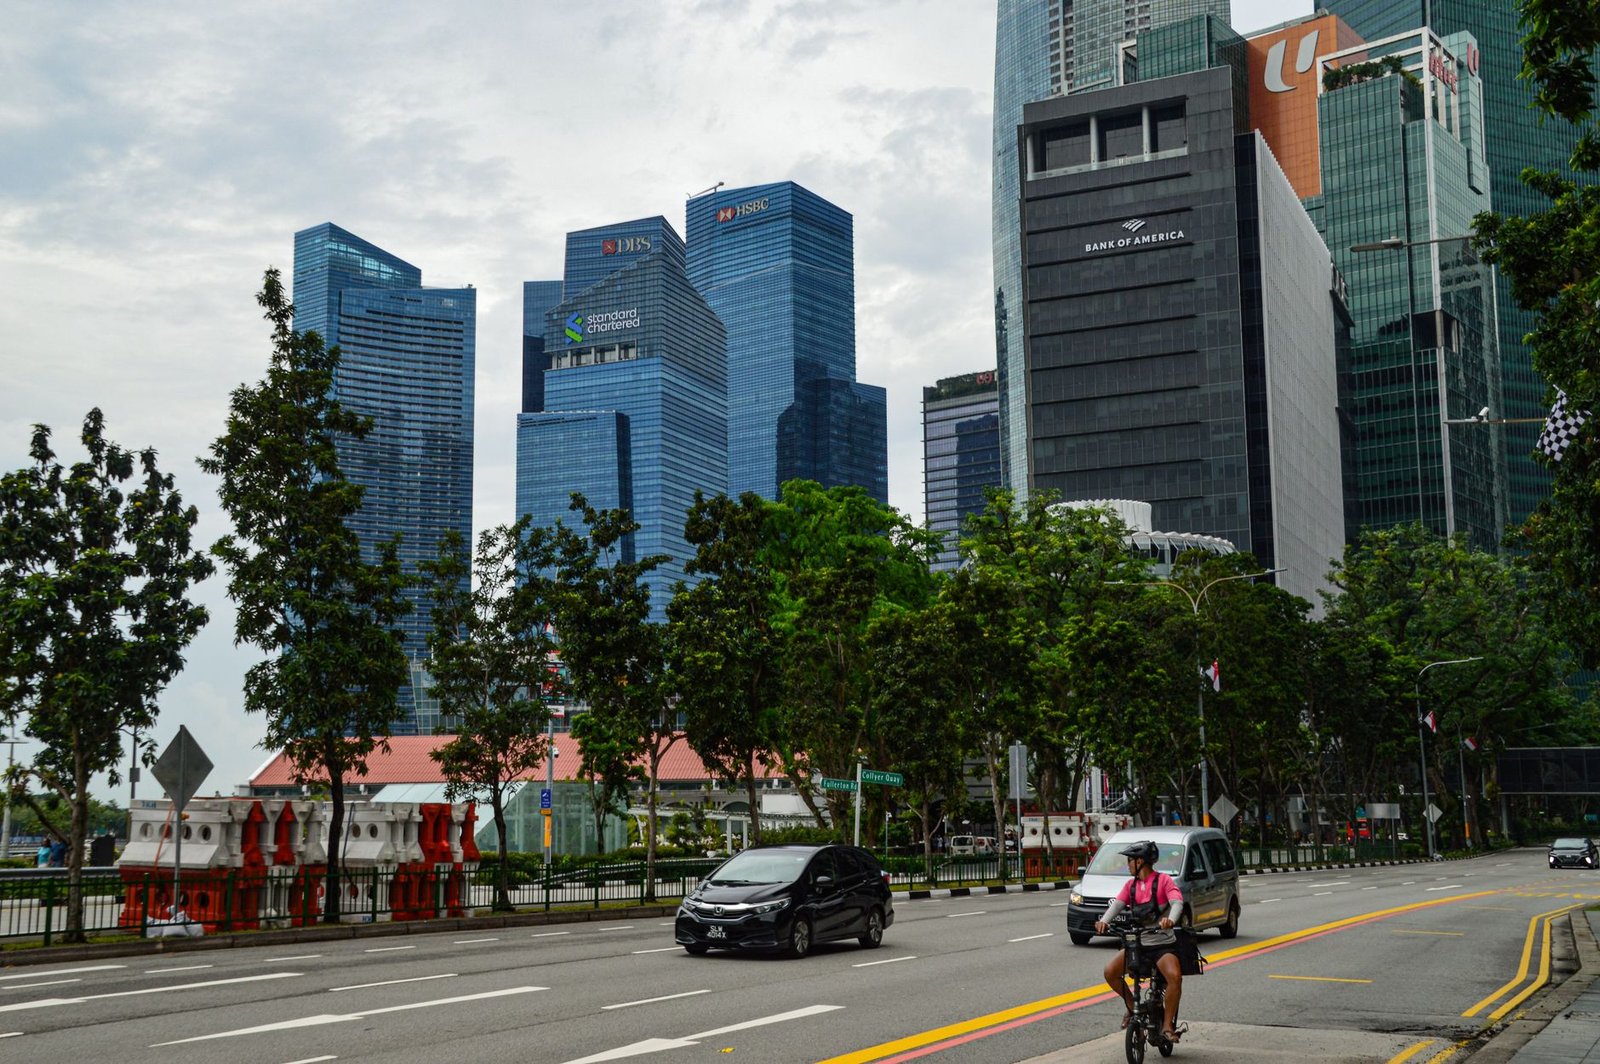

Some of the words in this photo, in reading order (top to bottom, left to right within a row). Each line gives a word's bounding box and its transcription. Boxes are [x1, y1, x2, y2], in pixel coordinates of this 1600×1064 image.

[736, 198, 769, 217] HSBC
[617, 237, 651, 253] DBS
[1085, 240, 1115, 252] BANK
[1117, 238, 1132, 247] OF
[1134, 230, 1184, 245] AMERICA
[587, 307, 637, 323] standard
[587, 317, 640, 334] chartered
[823, 780, 849, 790] Fullerton
[850, 782, 858, 790] Rd
[861, 771, 884, 780] Collyer
[885, 774, 901, 784] Quay
